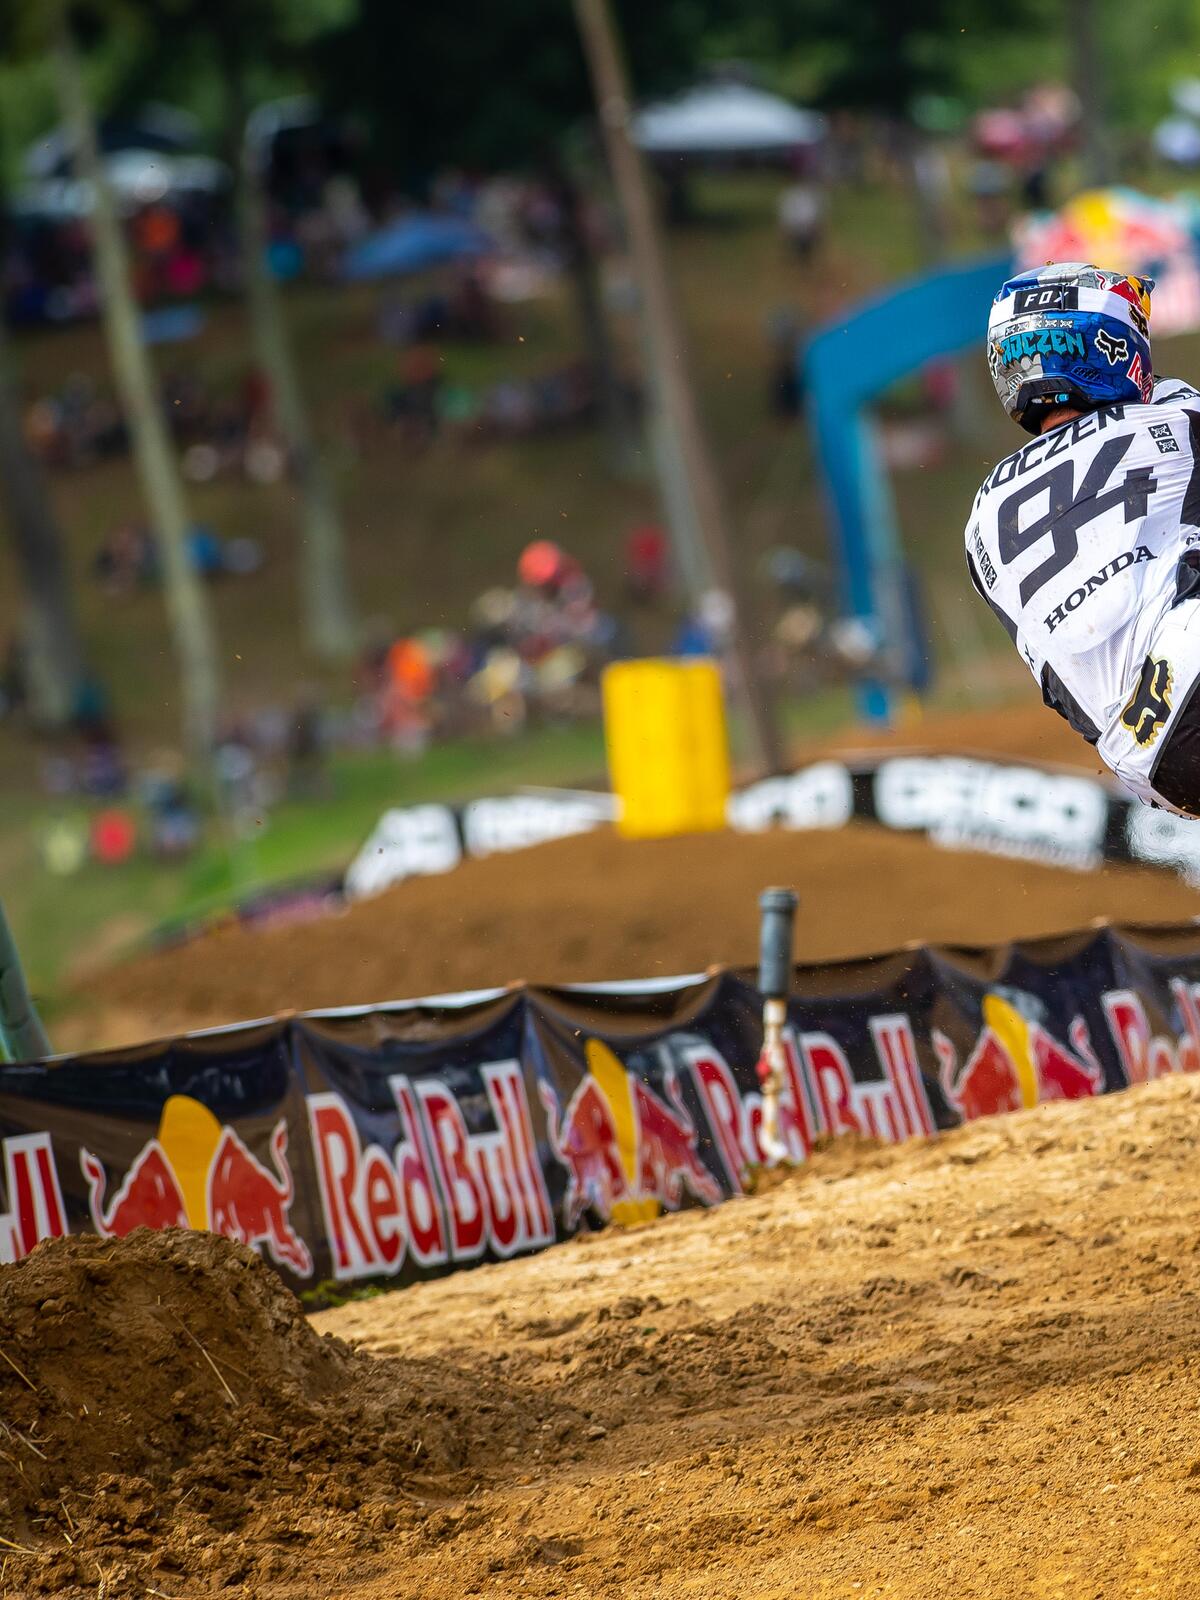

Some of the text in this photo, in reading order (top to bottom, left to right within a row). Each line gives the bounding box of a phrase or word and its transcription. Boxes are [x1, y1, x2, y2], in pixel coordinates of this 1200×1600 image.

[1023, 290, 1069, 308] FOX
[997, 432, 1158, 609] 94
[1043, 545, 1158, 635] HONDA
[799, 1013, 937, 1145] Bull
[307, 1058, 556, 1280] Red Bull
